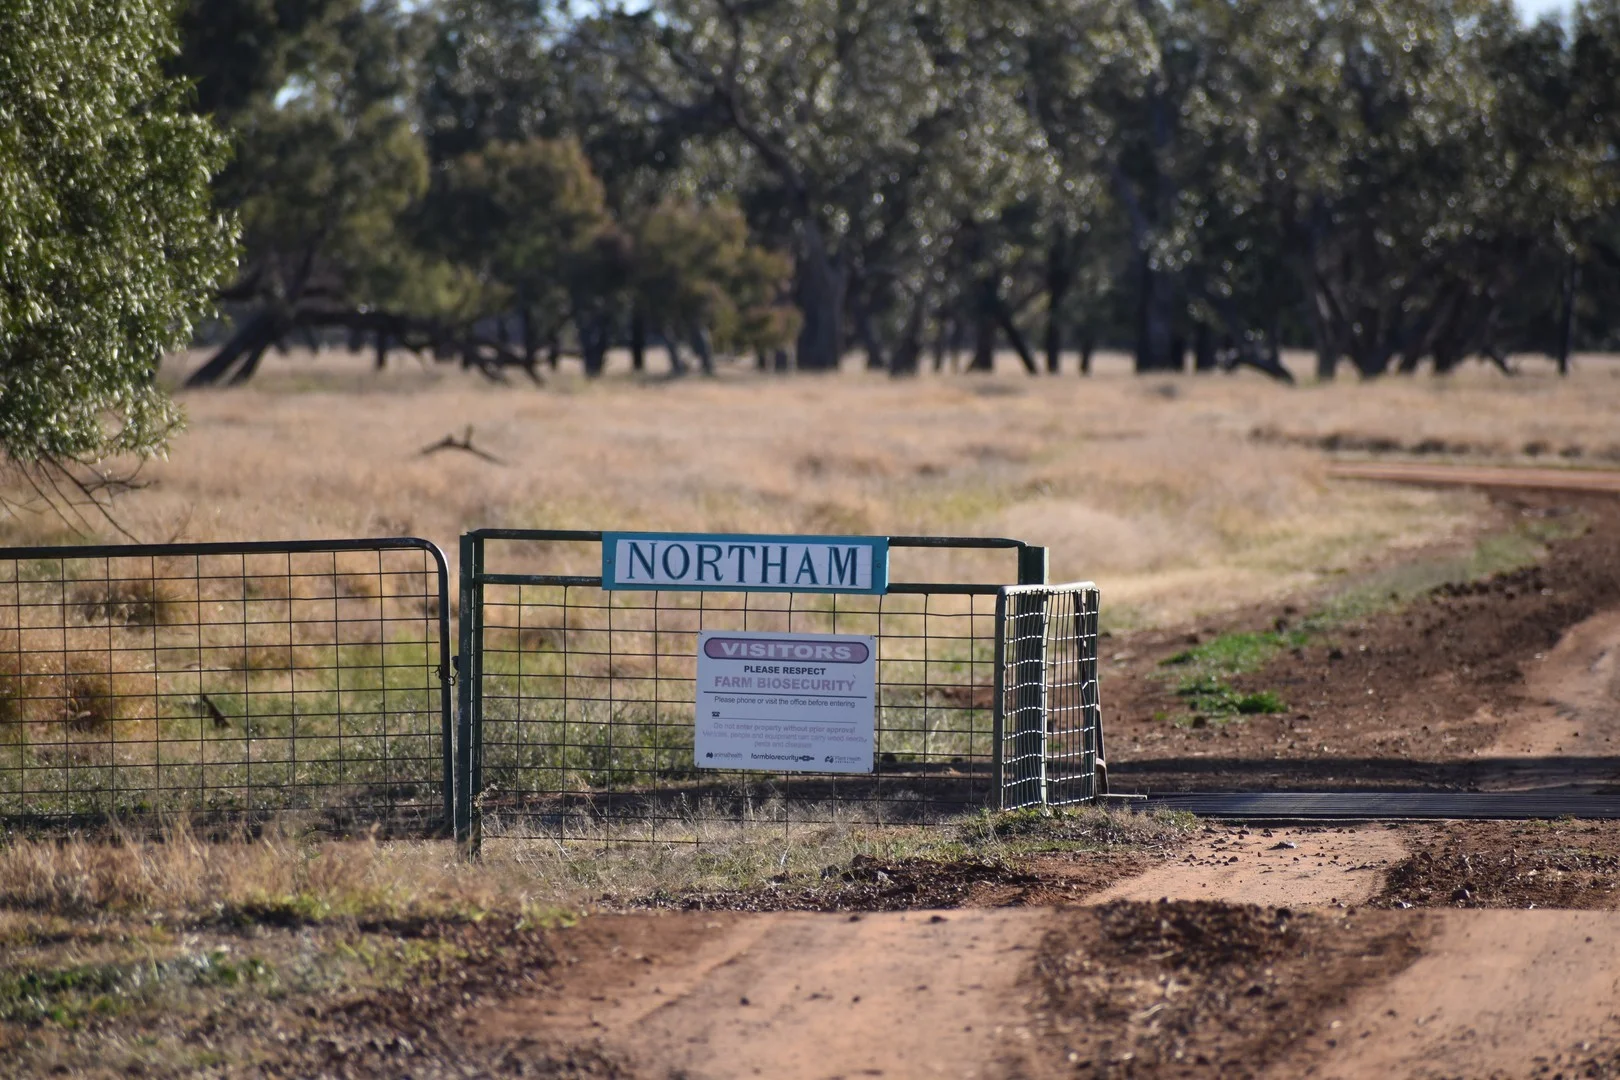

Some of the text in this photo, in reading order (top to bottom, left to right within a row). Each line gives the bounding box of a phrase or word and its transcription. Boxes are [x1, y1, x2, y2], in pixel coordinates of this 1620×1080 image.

[626, 542, 860, 586] NORTHAM
[721, 642, 852, 660] VISITORS
[744, 665, 826, 676] PLEASE RESPECT
[714, 676, 856, 691] FARM BIOSECURITY
[714, 696, 735, 704] Please
[736, 697, 756, 706] phone
[790, 698, 807, 706] office
[808, 699, 828, 707] before
[830, 700, 856, 708] entering
[754, 724, 781, 732] property
[783, 724, 808, 732] without
[809, 726, 824, 734] prior
[826, 726, 856, 734] approval
